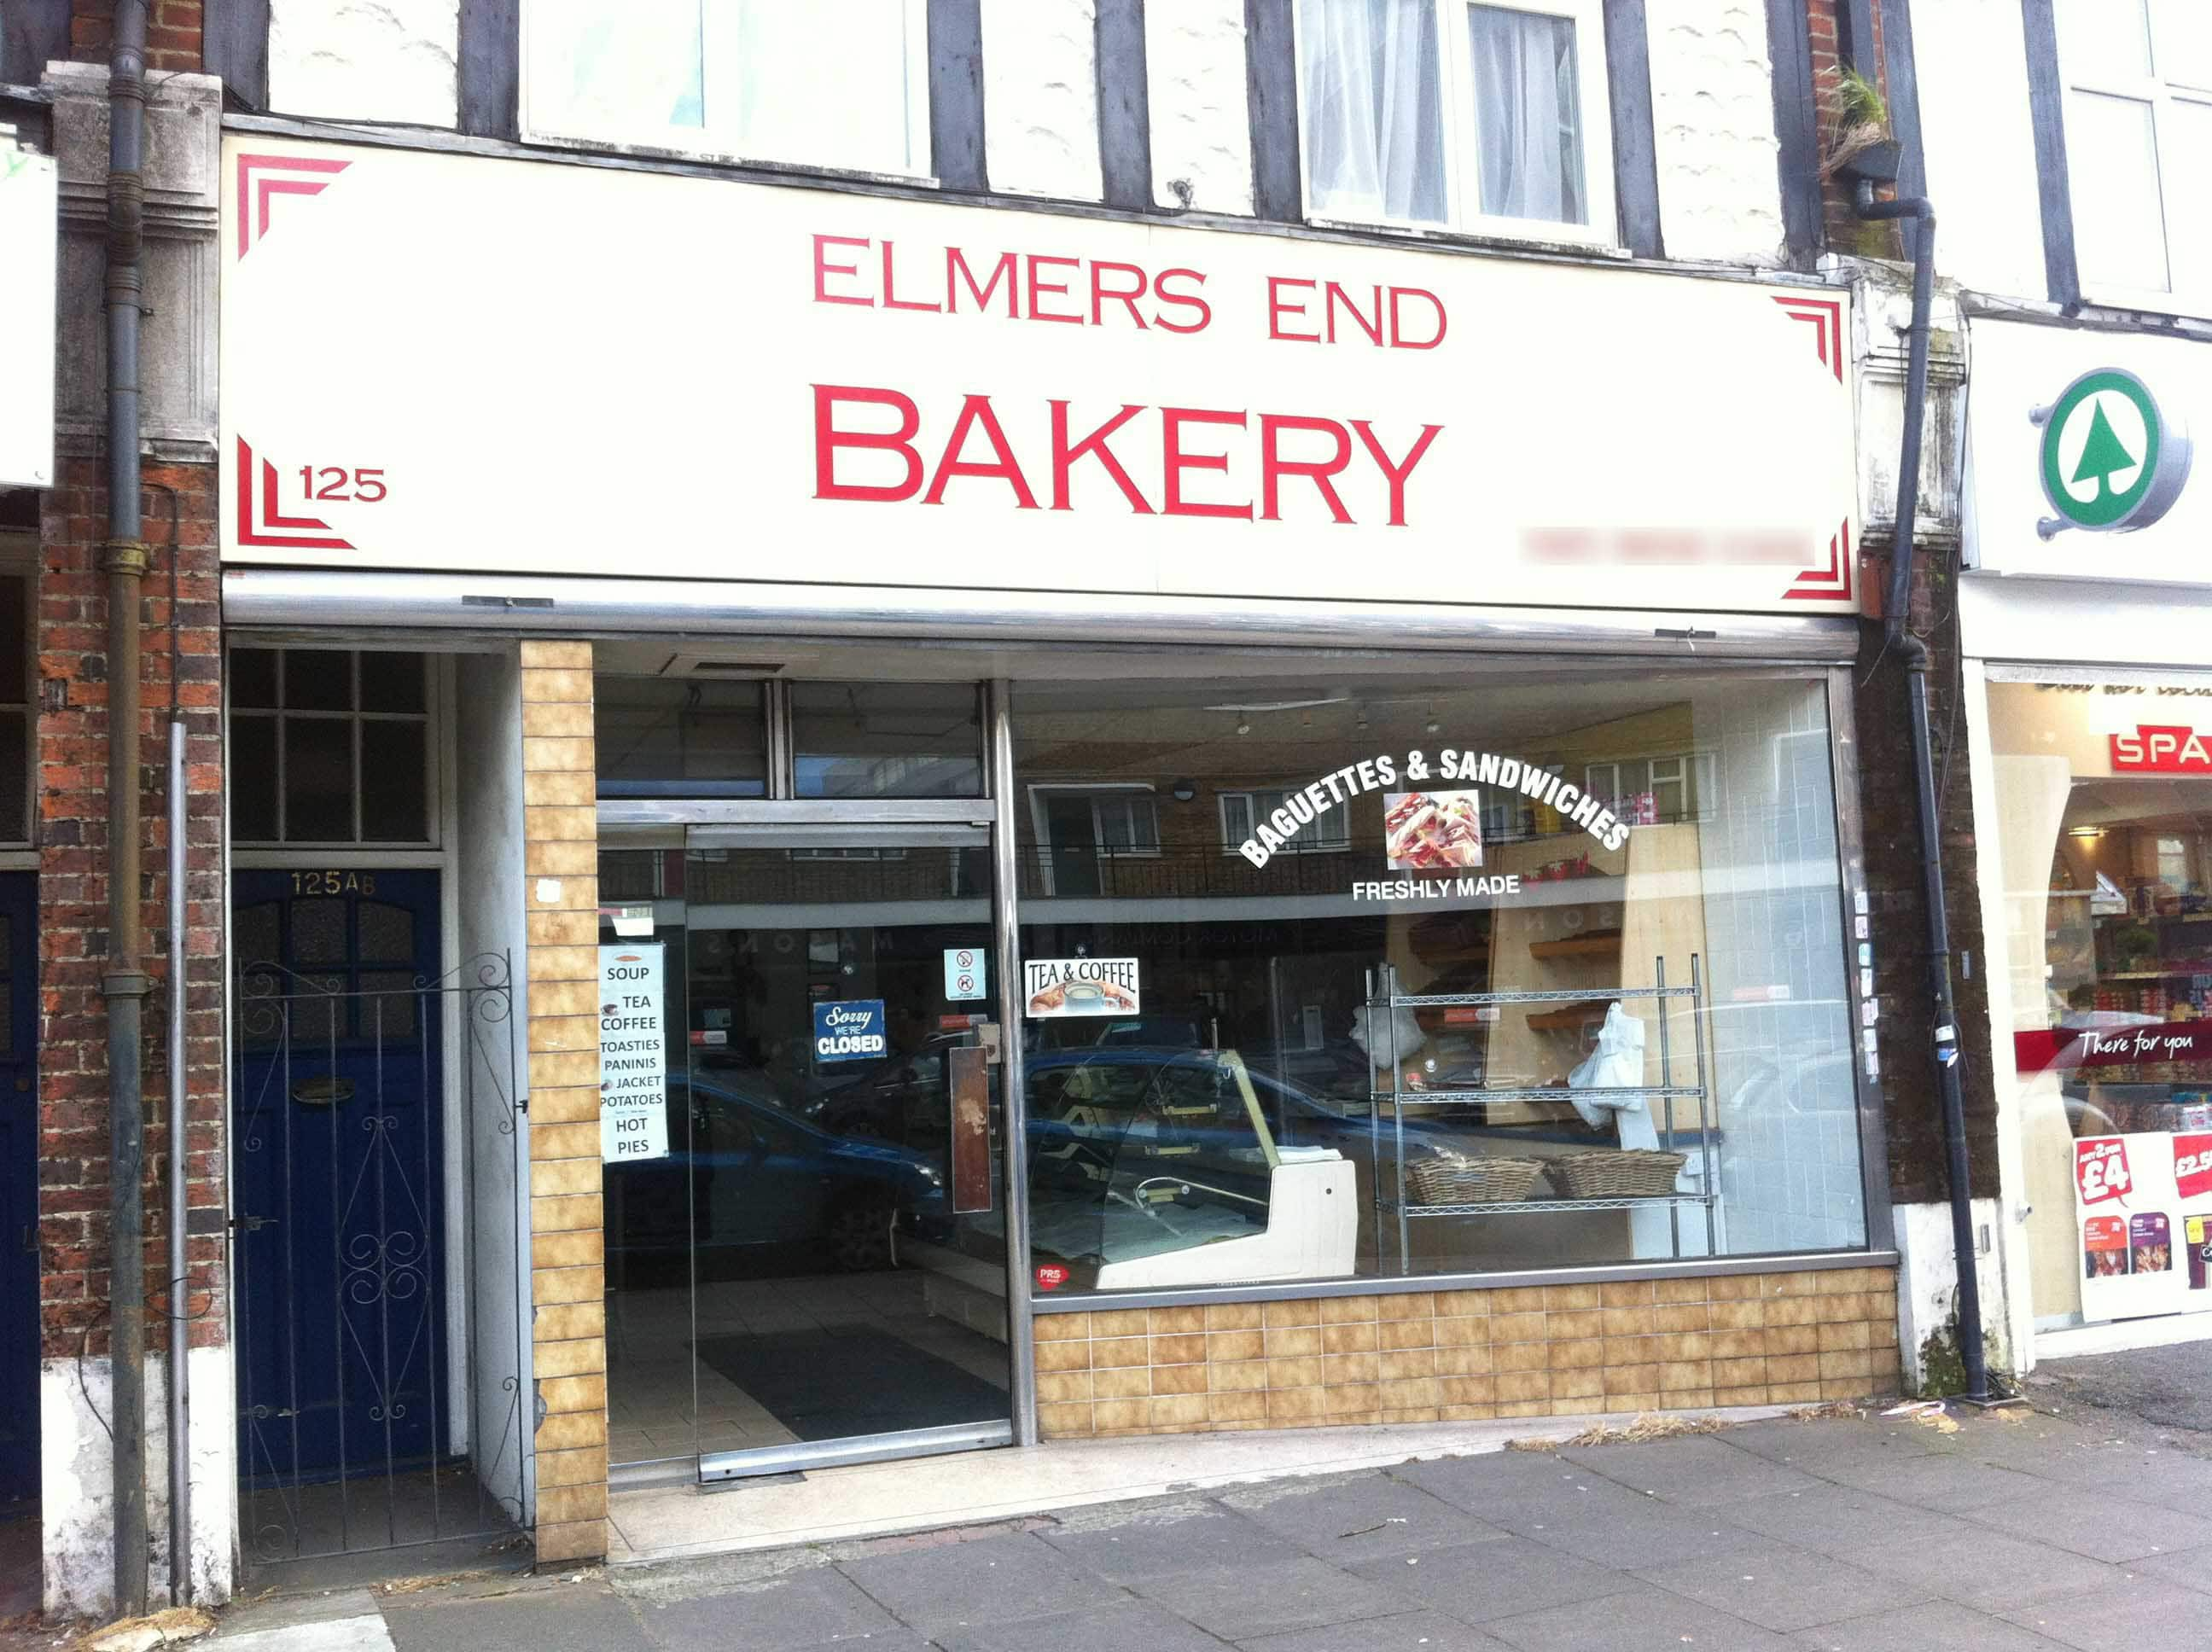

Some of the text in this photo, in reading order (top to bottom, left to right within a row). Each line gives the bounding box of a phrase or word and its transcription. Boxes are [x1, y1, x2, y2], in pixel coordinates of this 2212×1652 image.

[812, 234, 1447, 350] ELMERS END
[809, 383, 1445, 526] BAKERY
[300, 465, 387, 503] 125
[2116, 733, 2211, 765] SPA
[1239, 748, 1630, 870] BAGUETTES & SANDWICHES
[1353, 875, 1521, 901] FRESHLY MADE
[607, 967, 649, 980] SOUP
[1028, 962, 1135, 994] TEA & COFFEE
[622, 996, 651, 1009] TEA
[601, 1017, 656, 1031] COFFEE
[825, 1006, 872, 1030] Sorry
[600, 1039, 660, 1053] TOASTIES
[818, 1035, 883, 1055] CLOSED
[2078, 1030, 2193, 1060] There for you
[604, 1057, 656, 1071] PANINIS
[616, 1075, 661, 1089] JACKET
[600, 1093, 663, 1108] POTATOES
[616, 1118, 648, 1133] HOT
[618, 1139, 649, 1154] PIES
[2094, 1143, 2104, 1158] 2
[2081, 1155, 2129, 1200] £4
[1040, 1269, 1061, 1278] PRS
